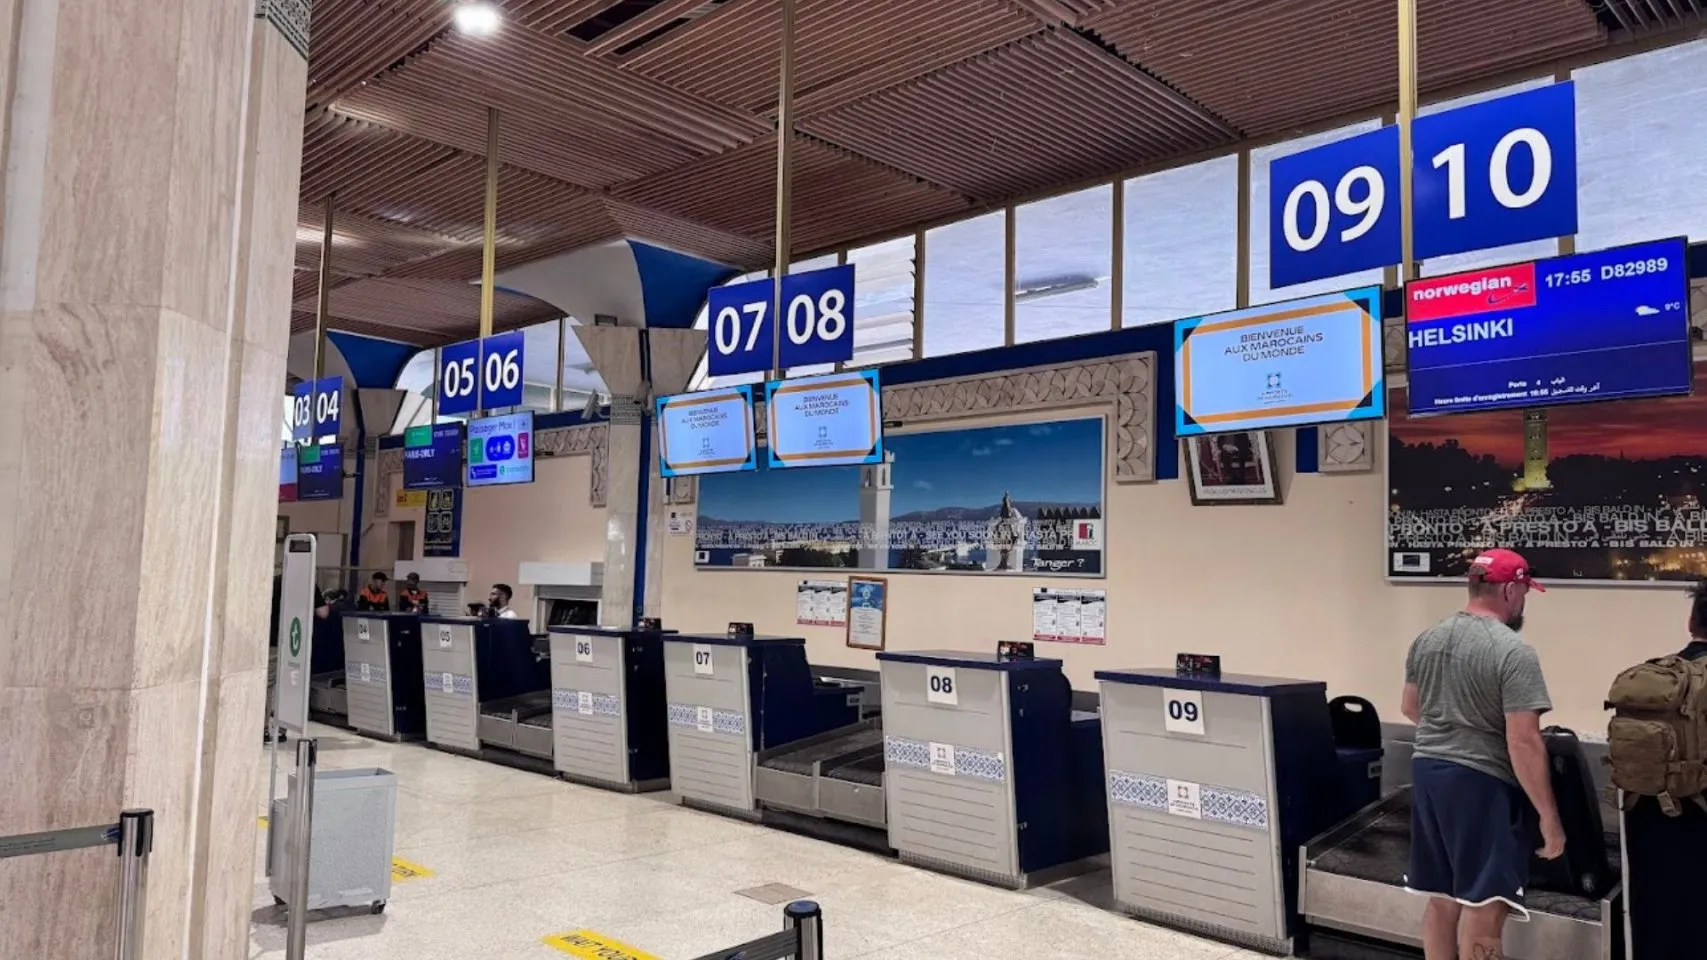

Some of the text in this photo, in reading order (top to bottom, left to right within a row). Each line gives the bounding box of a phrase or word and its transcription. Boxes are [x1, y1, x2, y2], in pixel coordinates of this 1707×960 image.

[1431, 127, 1552, 220] 10
[1282, 164, 1385, 252] 09
[1545, 257, 1668, 288] 17:55 D82989
[1413, 275, 1512, 301] norwegian
[787, 288, 846, 345] 08
[715, 301, 767, 355] 07
[1240, 325, 1305, 343] BIENVENUE
[1408, 318, 1514, 349] HELSINKI
[1224, 332, 1324, 356] AUX MAROCAINS
[1242, 345, 1305, 362] DU MONDE
[444, 357, 475, 398] 05
[485, 349, 519, 392] 06
[295, 394, 311, 427] 03
[317, 390, 339, 424] 04
[1573, 513, 1595, 523] BIS
[1600, 512, 1638, 522] BALD
[1584, 505, 1600, 514] BIS
[1602, 505, 1633, 514] BALD
[926, 531, 945, 540] SEE
[945, 531, 966, 539] YOU
[968, 531, 997, 540] SOON
[1389, 522, 1464, 534] PRONTO
[1481, 519, 1496, 533] A
[1501, 520, 1579, 534] PRESTO
[1582, 520, 1597, 532] A
[1614, 519, 1649, 532] BIS
[1397, 533, 1453, 545] PRESTO
[1536, 540, 1588, 548] PRESTO
[1609, 540, 1635, 548] BIS
[1639, 540, 1675, 548] BALD
[1031, 557, 1074, 571] Tanger
[441, 631, 450, 642] 05
[577, 642, 590, 655] 06
[696, 651, 710, 665] 07
[931, 675, 952, 693] 08
[1168, 700, 1198, 722] 09
